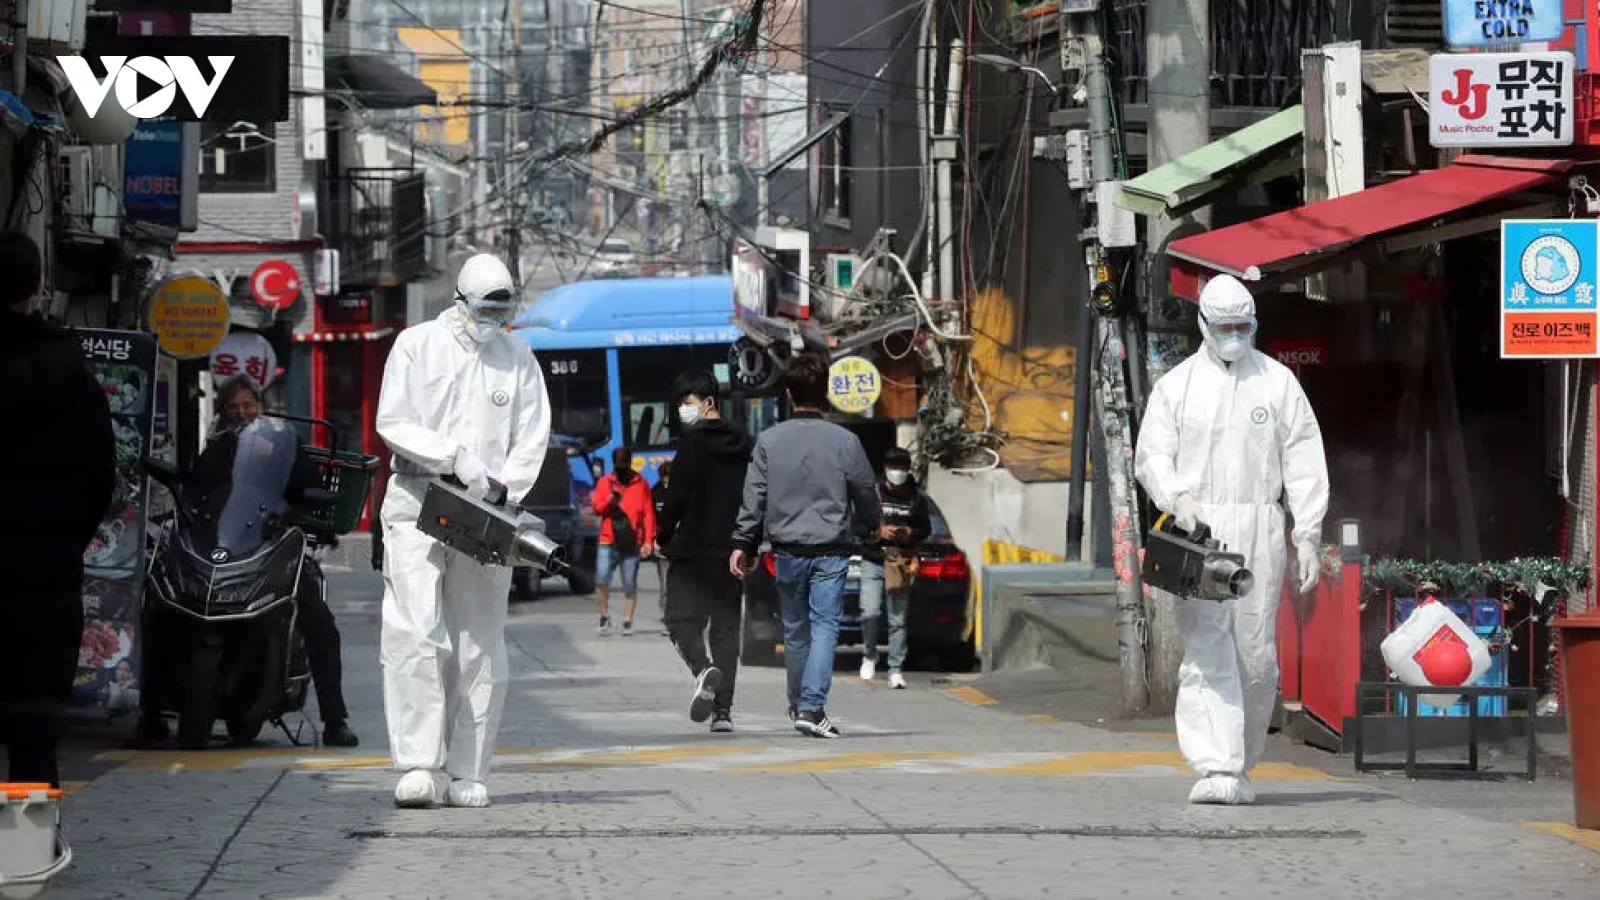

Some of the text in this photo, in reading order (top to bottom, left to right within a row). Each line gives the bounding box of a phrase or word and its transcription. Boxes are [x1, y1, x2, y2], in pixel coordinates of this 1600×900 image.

[1474, 0, 1534, 19] EXTRA
[1481, 19, 1530, 39] COLD
[1496, 60, 1563, 100] 뮤직
[1441, 69, 1491, 120] JJ
[1439, 124, 1494, 133] Music Pocha
[1497, 99, 1566, 139] 포차
[126, 176, 181, 194] NOBEL
[1512, 323, 1591, 338] 진로 이즈 백
